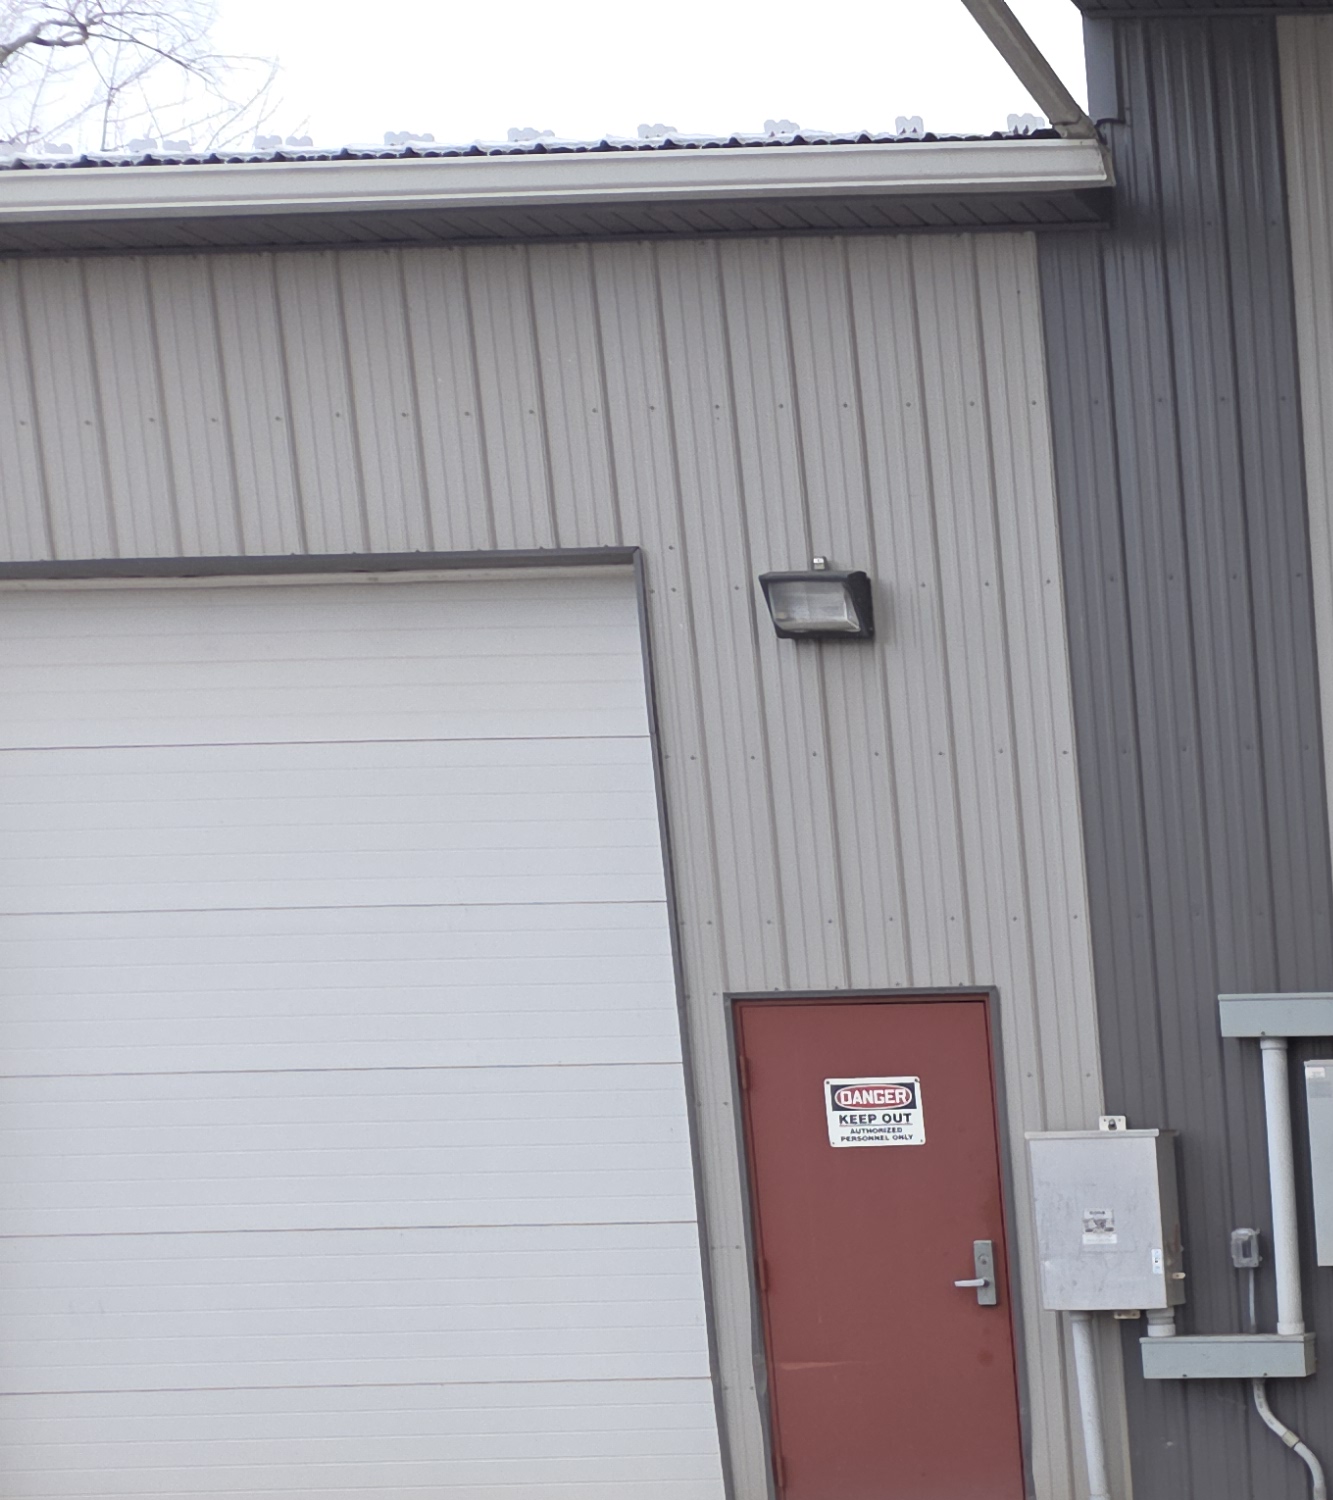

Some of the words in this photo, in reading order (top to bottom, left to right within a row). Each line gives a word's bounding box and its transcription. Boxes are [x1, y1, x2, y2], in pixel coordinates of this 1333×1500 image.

[840, 1088, 907, 1105] DANGER
[839, 1113, 877, 1125] KEEP
[881, 1112, 912, 1124] OUT
[850, 1127, 903, 1135] AUTHORIZED
